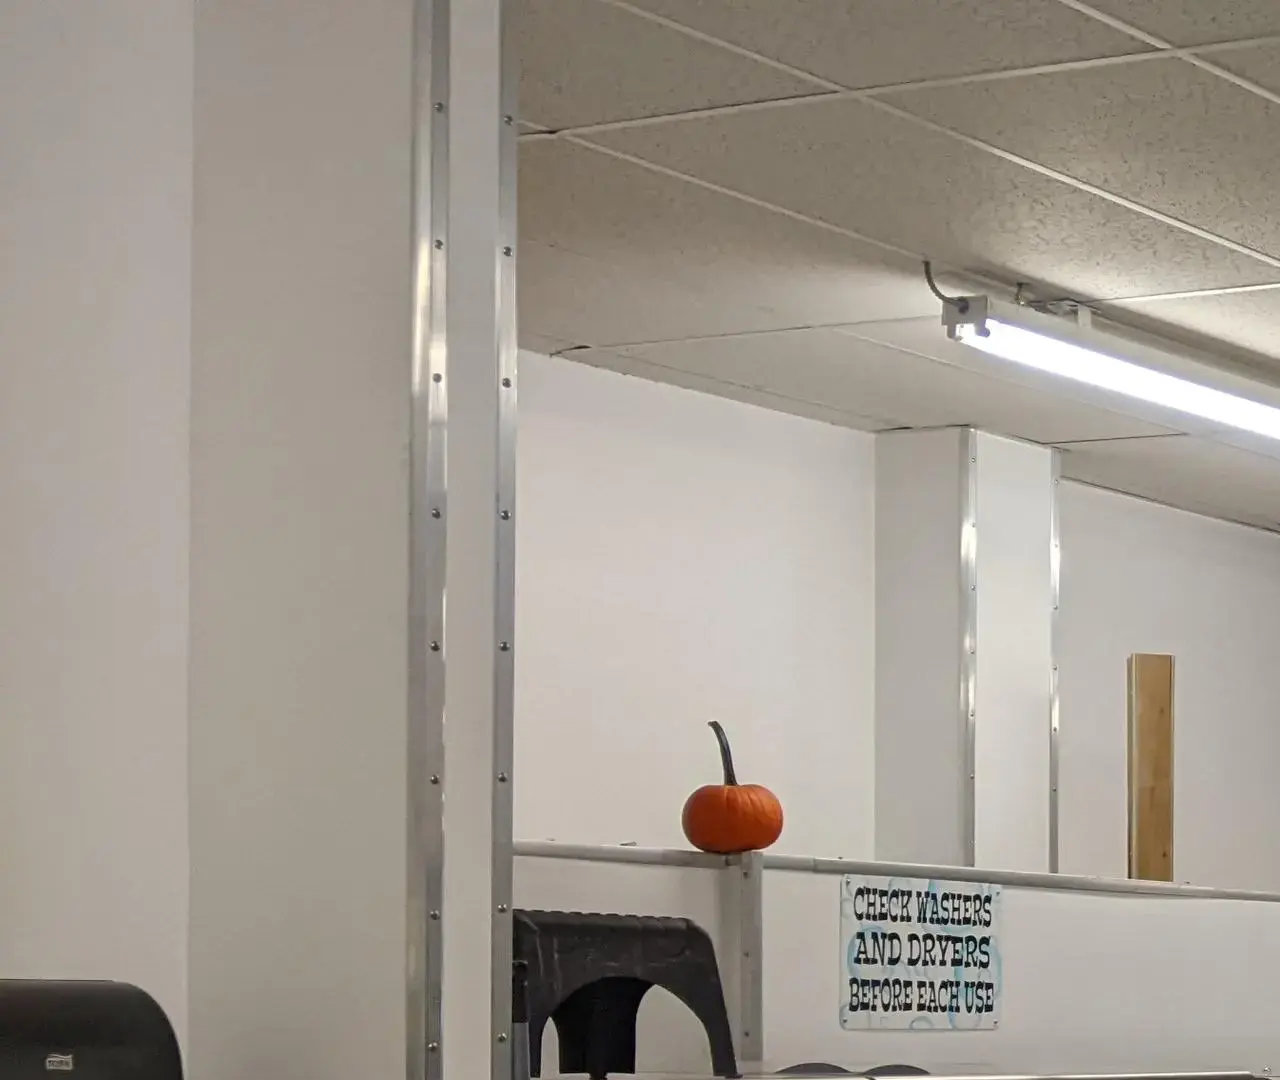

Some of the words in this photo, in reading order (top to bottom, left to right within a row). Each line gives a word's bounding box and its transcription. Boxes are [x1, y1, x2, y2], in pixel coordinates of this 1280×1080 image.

[853, 887, 912, 922] CHECK
[915, 891, 992, 927] WASHERS
[853, 932, 901, 966] AND
[907, 933, 991, 969] DRYERS
[848, 977, 913, 1012] BEFORE
[916, 979, 960, 1013] EACH
[963, 980, 994, 1014] USE
